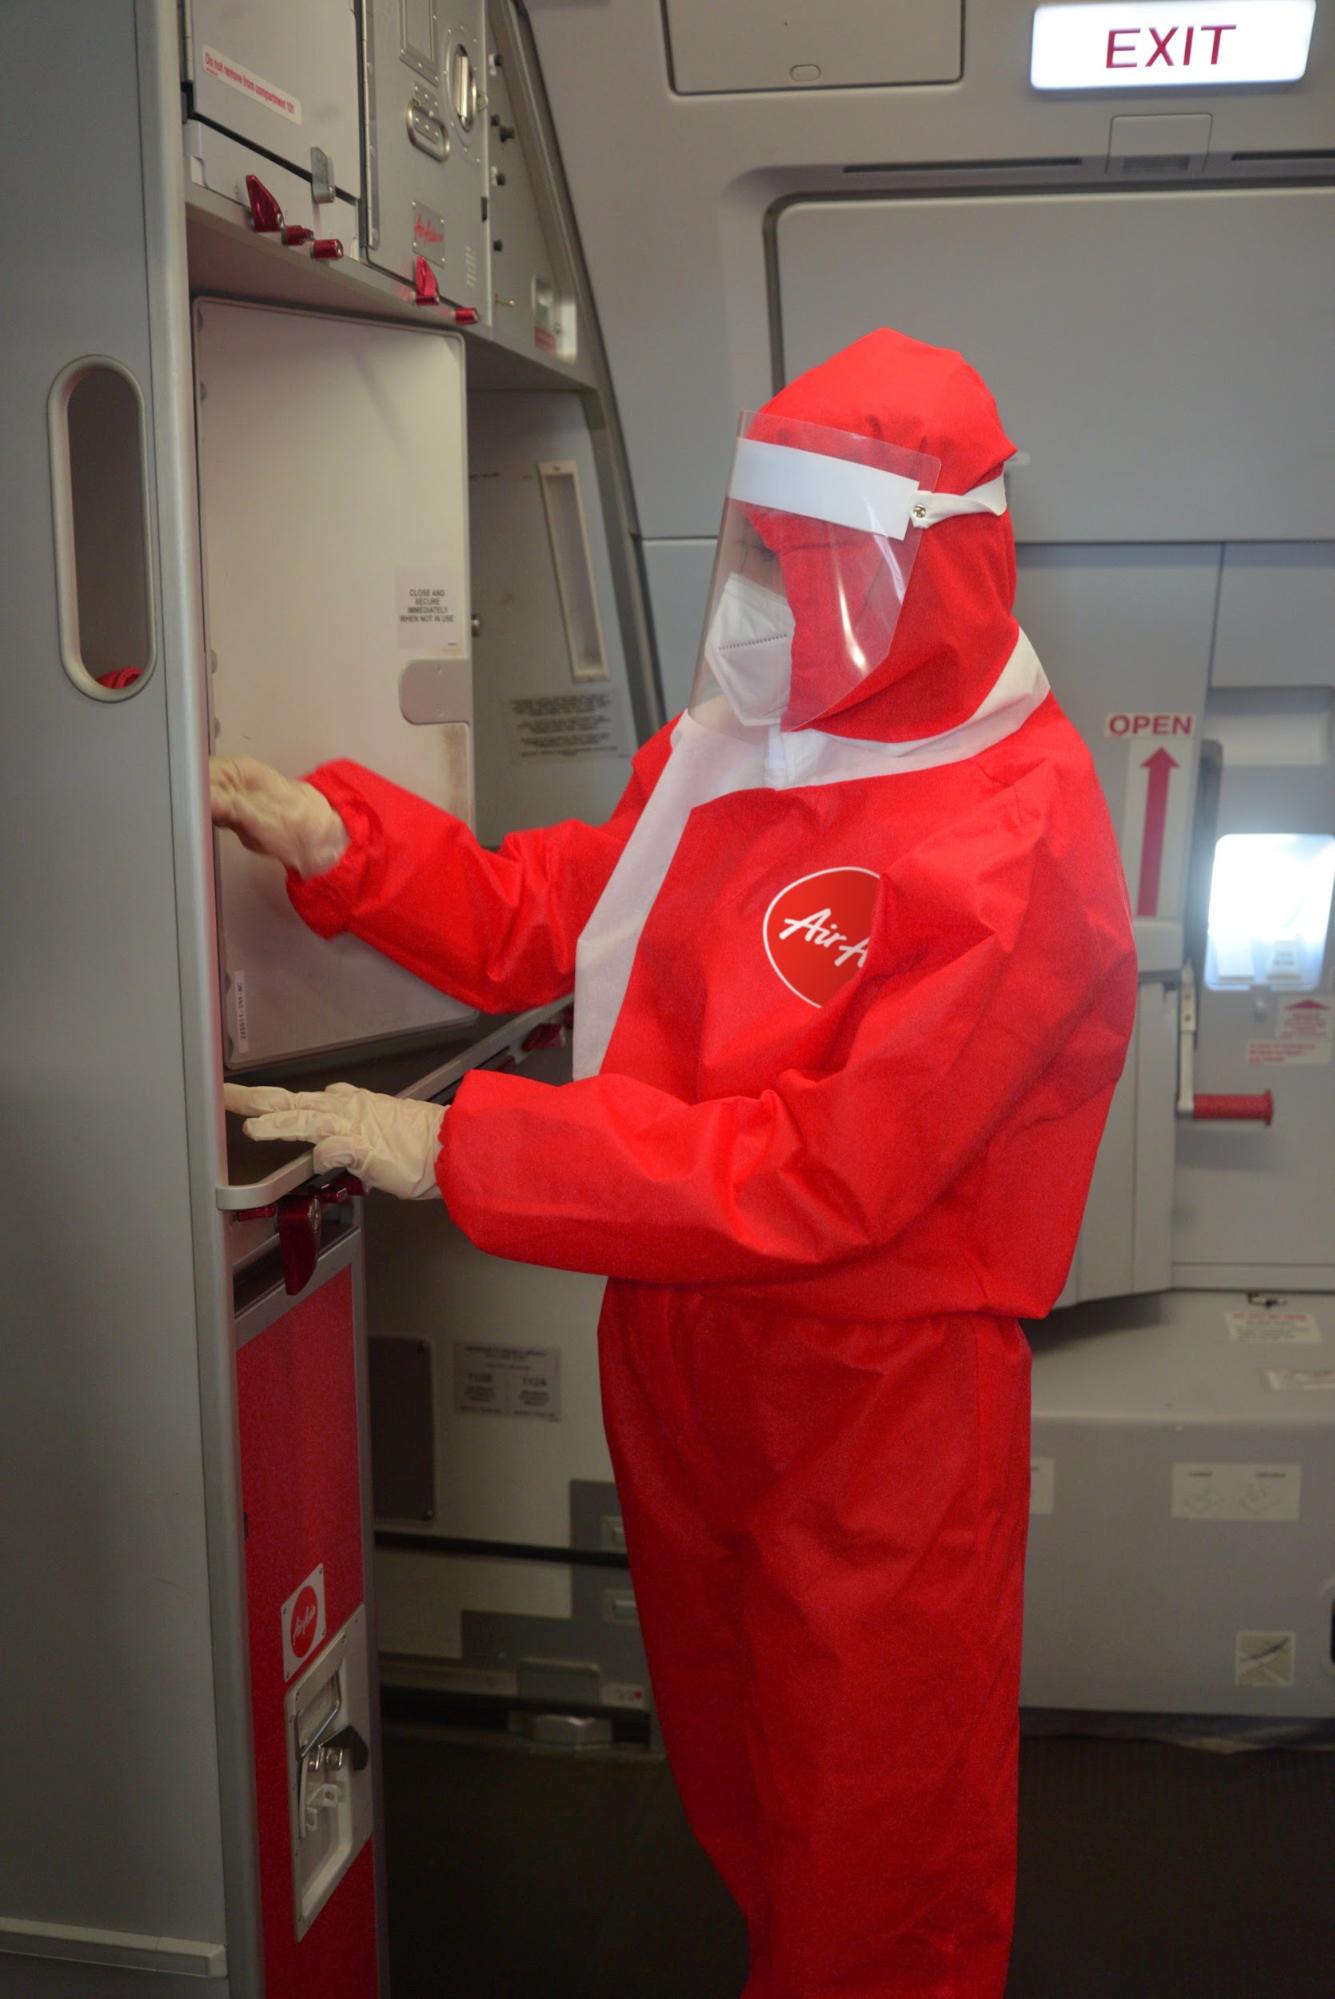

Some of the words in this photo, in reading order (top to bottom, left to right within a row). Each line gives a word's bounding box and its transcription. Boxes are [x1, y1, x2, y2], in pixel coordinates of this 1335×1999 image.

[1106, 24, 1237, 68] EXIT
[409, 588, 430, 597] CLOSE
[432, 588, 446, 597] AND
[415, 598, 441, 606] SECURE
[407, 606, 449, 614] IMMEDIATELY
[399, 614, 419, 623] WHEN
[419, 614, 433, 623] NOT
[434, 614, 441, 622] IN
[442, 614, 455, 623] USE
[1109, 714, 1193, 737] OPEN
